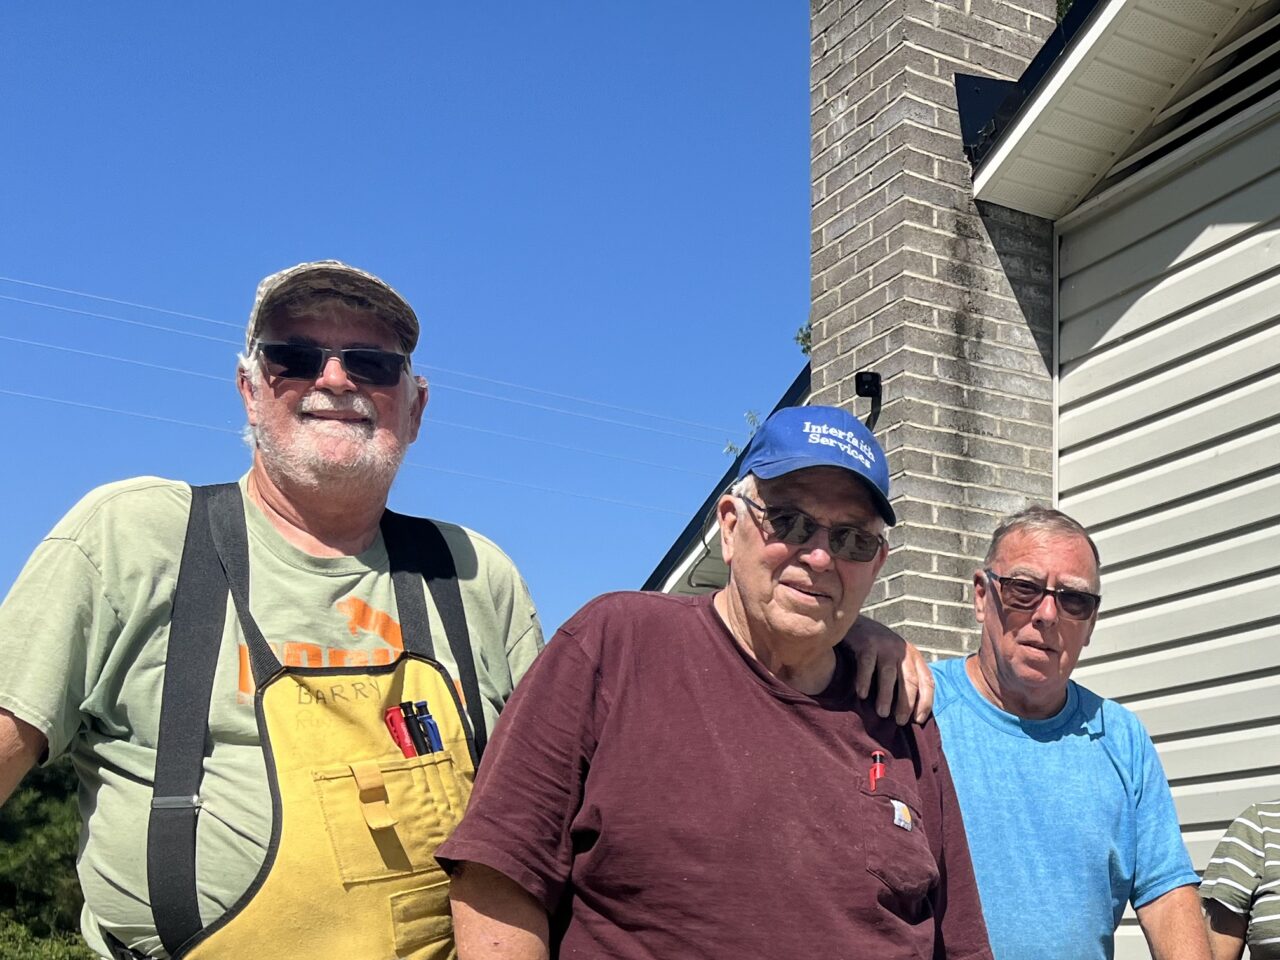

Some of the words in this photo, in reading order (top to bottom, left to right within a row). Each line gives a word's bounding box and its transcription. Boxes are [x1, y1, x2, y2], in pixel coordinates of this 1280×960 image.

[802, 421, 877, 463] Interfaith
[808, 433, 872, 469] Services
[296, 679, 382, 705] BARRY
